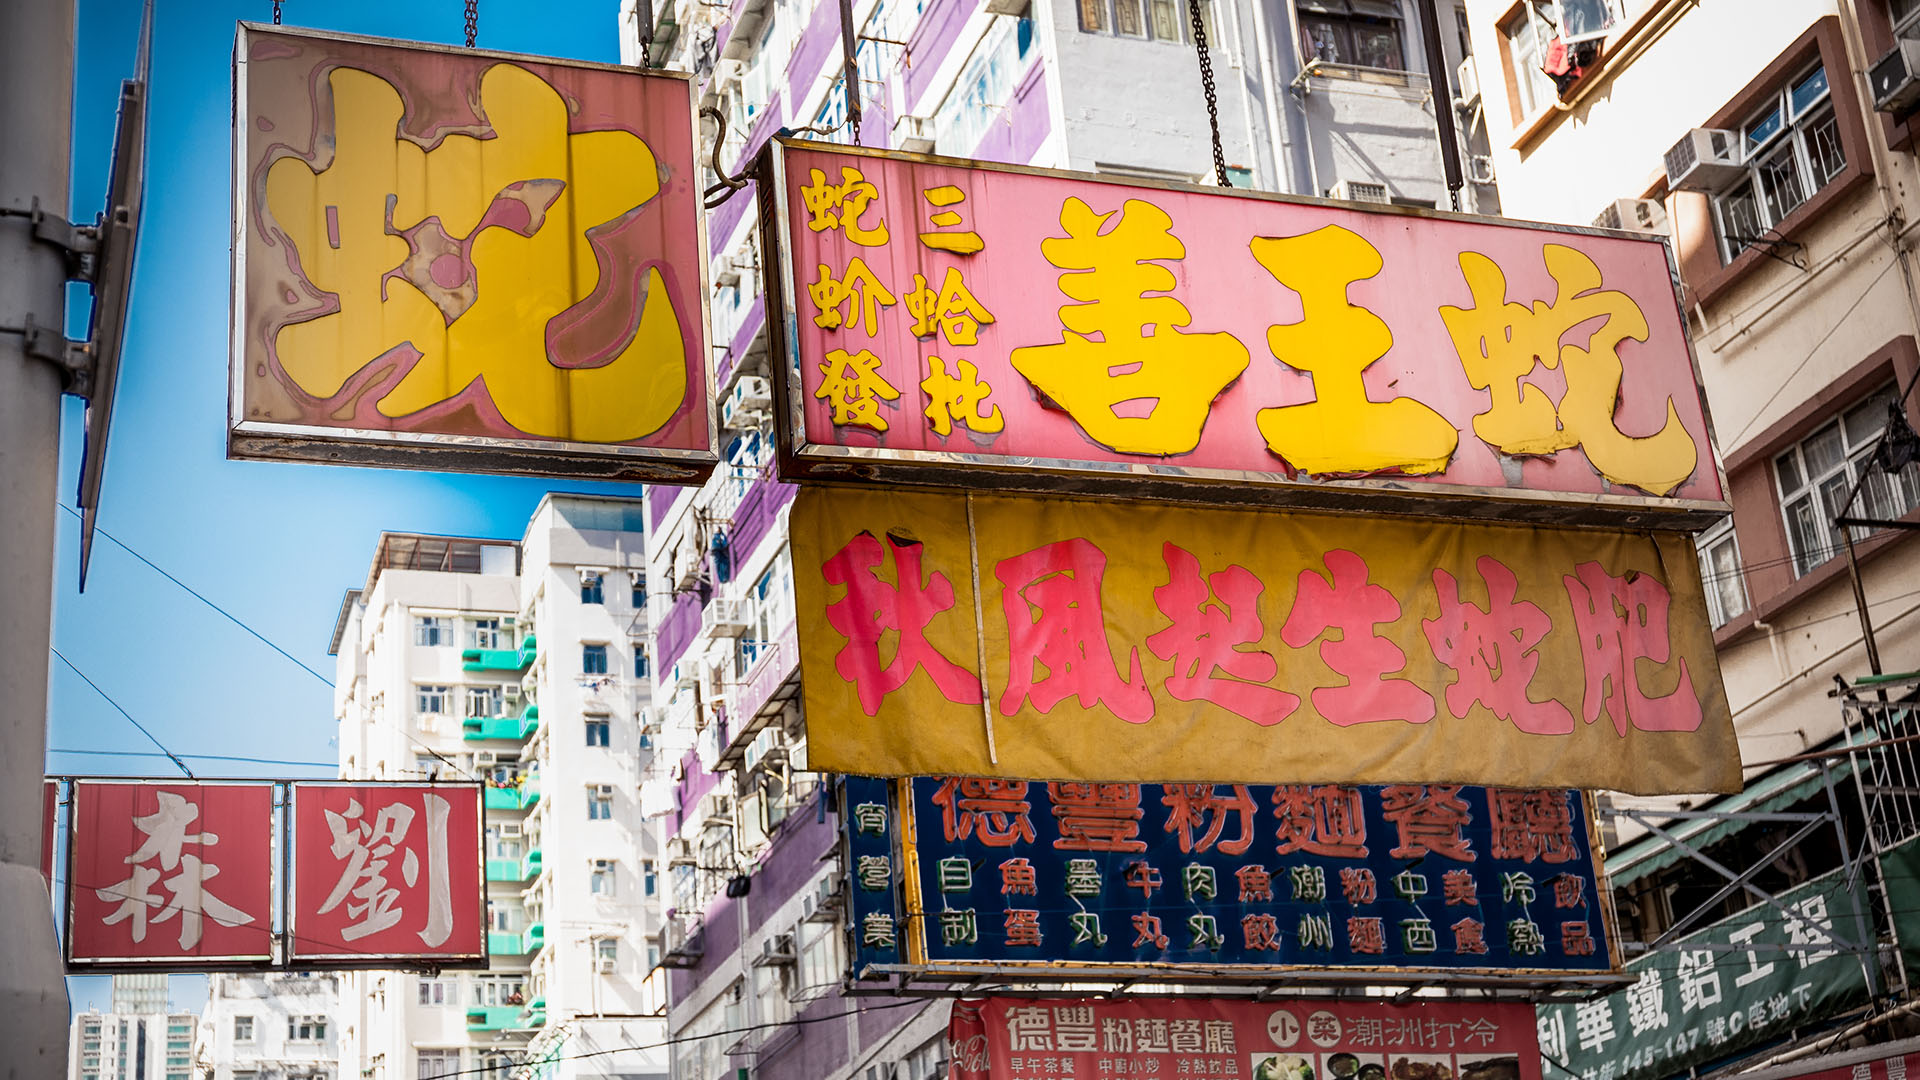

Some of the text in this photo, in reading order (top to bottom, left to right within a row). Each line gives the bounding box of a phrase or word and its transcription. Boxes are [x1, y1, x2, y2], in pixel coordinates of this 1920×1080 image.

[267, 63, 687, 443] 蛇
[1005, 1006, 1237, 1055] 德豐粉麵餐廳
[1010, 1057, 1075, 1074] 早午茶餐
[1176, 1058, 1239, 1075] 冷熱飲品
